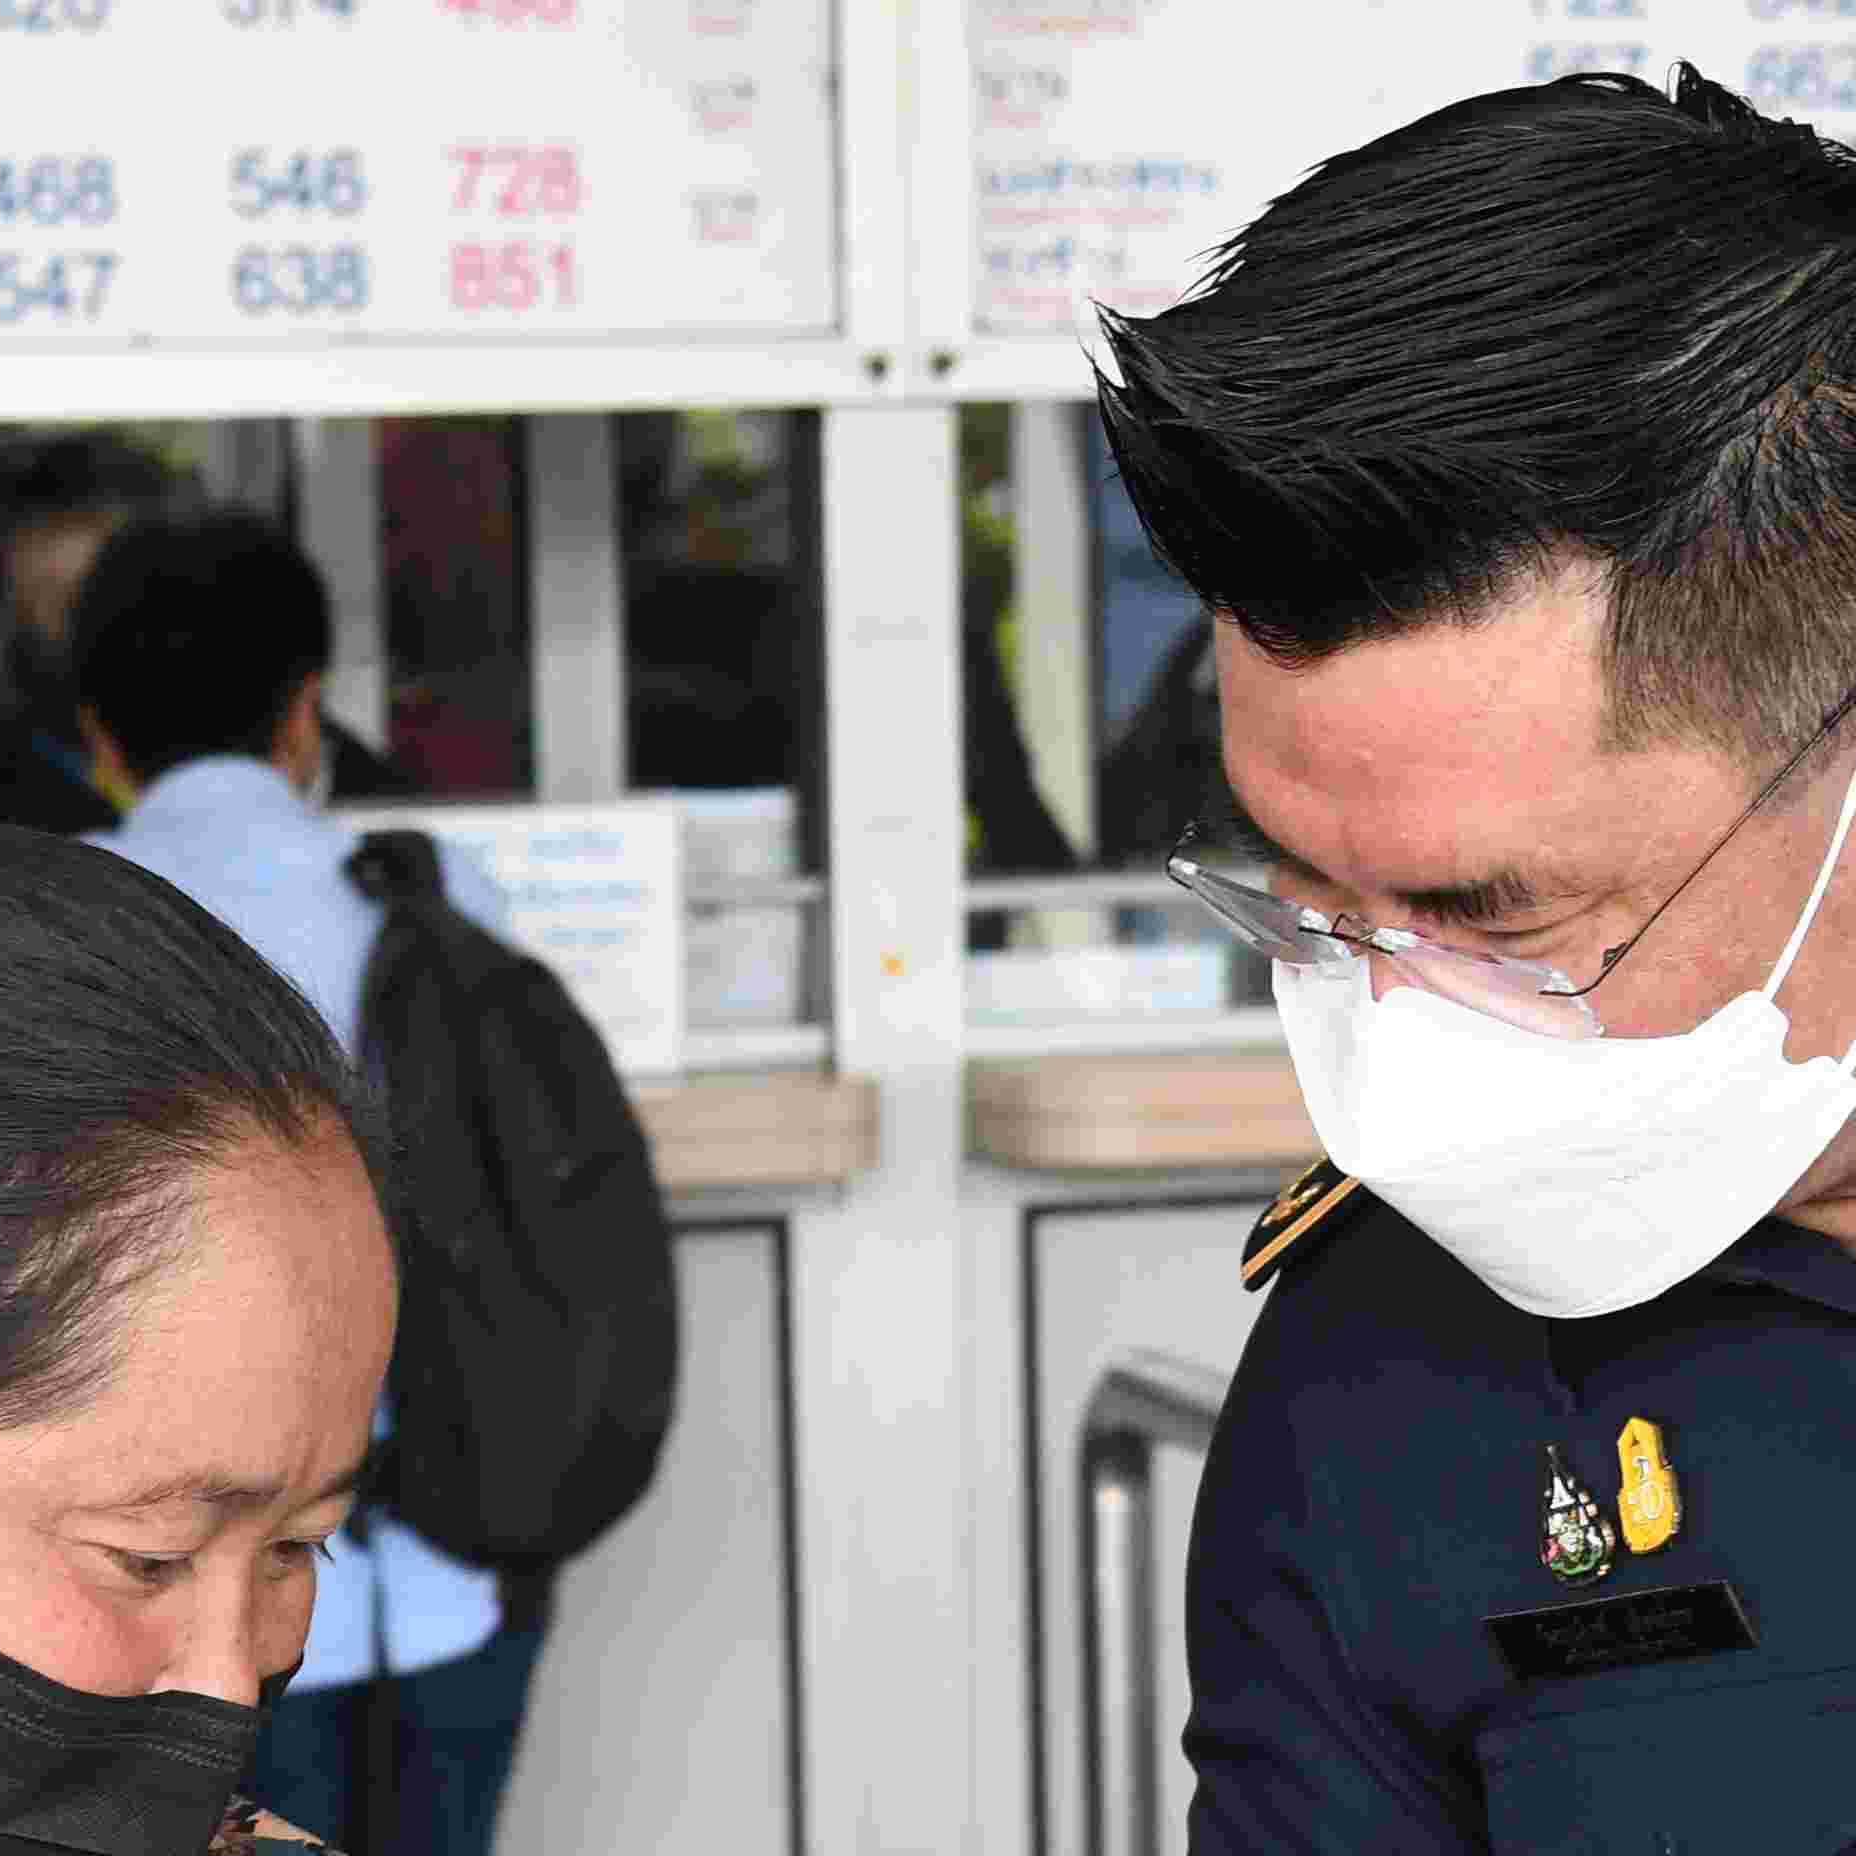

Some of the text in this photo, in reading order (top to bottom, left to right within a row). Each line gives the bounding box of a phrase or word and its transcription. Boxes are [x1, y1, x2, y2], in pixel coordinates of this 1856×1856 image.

[231, 148, 368, 219] 546
[447, 143, 589, 222] 728
[231, 243, 370, 316] 638
[449, 239, 577, 313] 851
